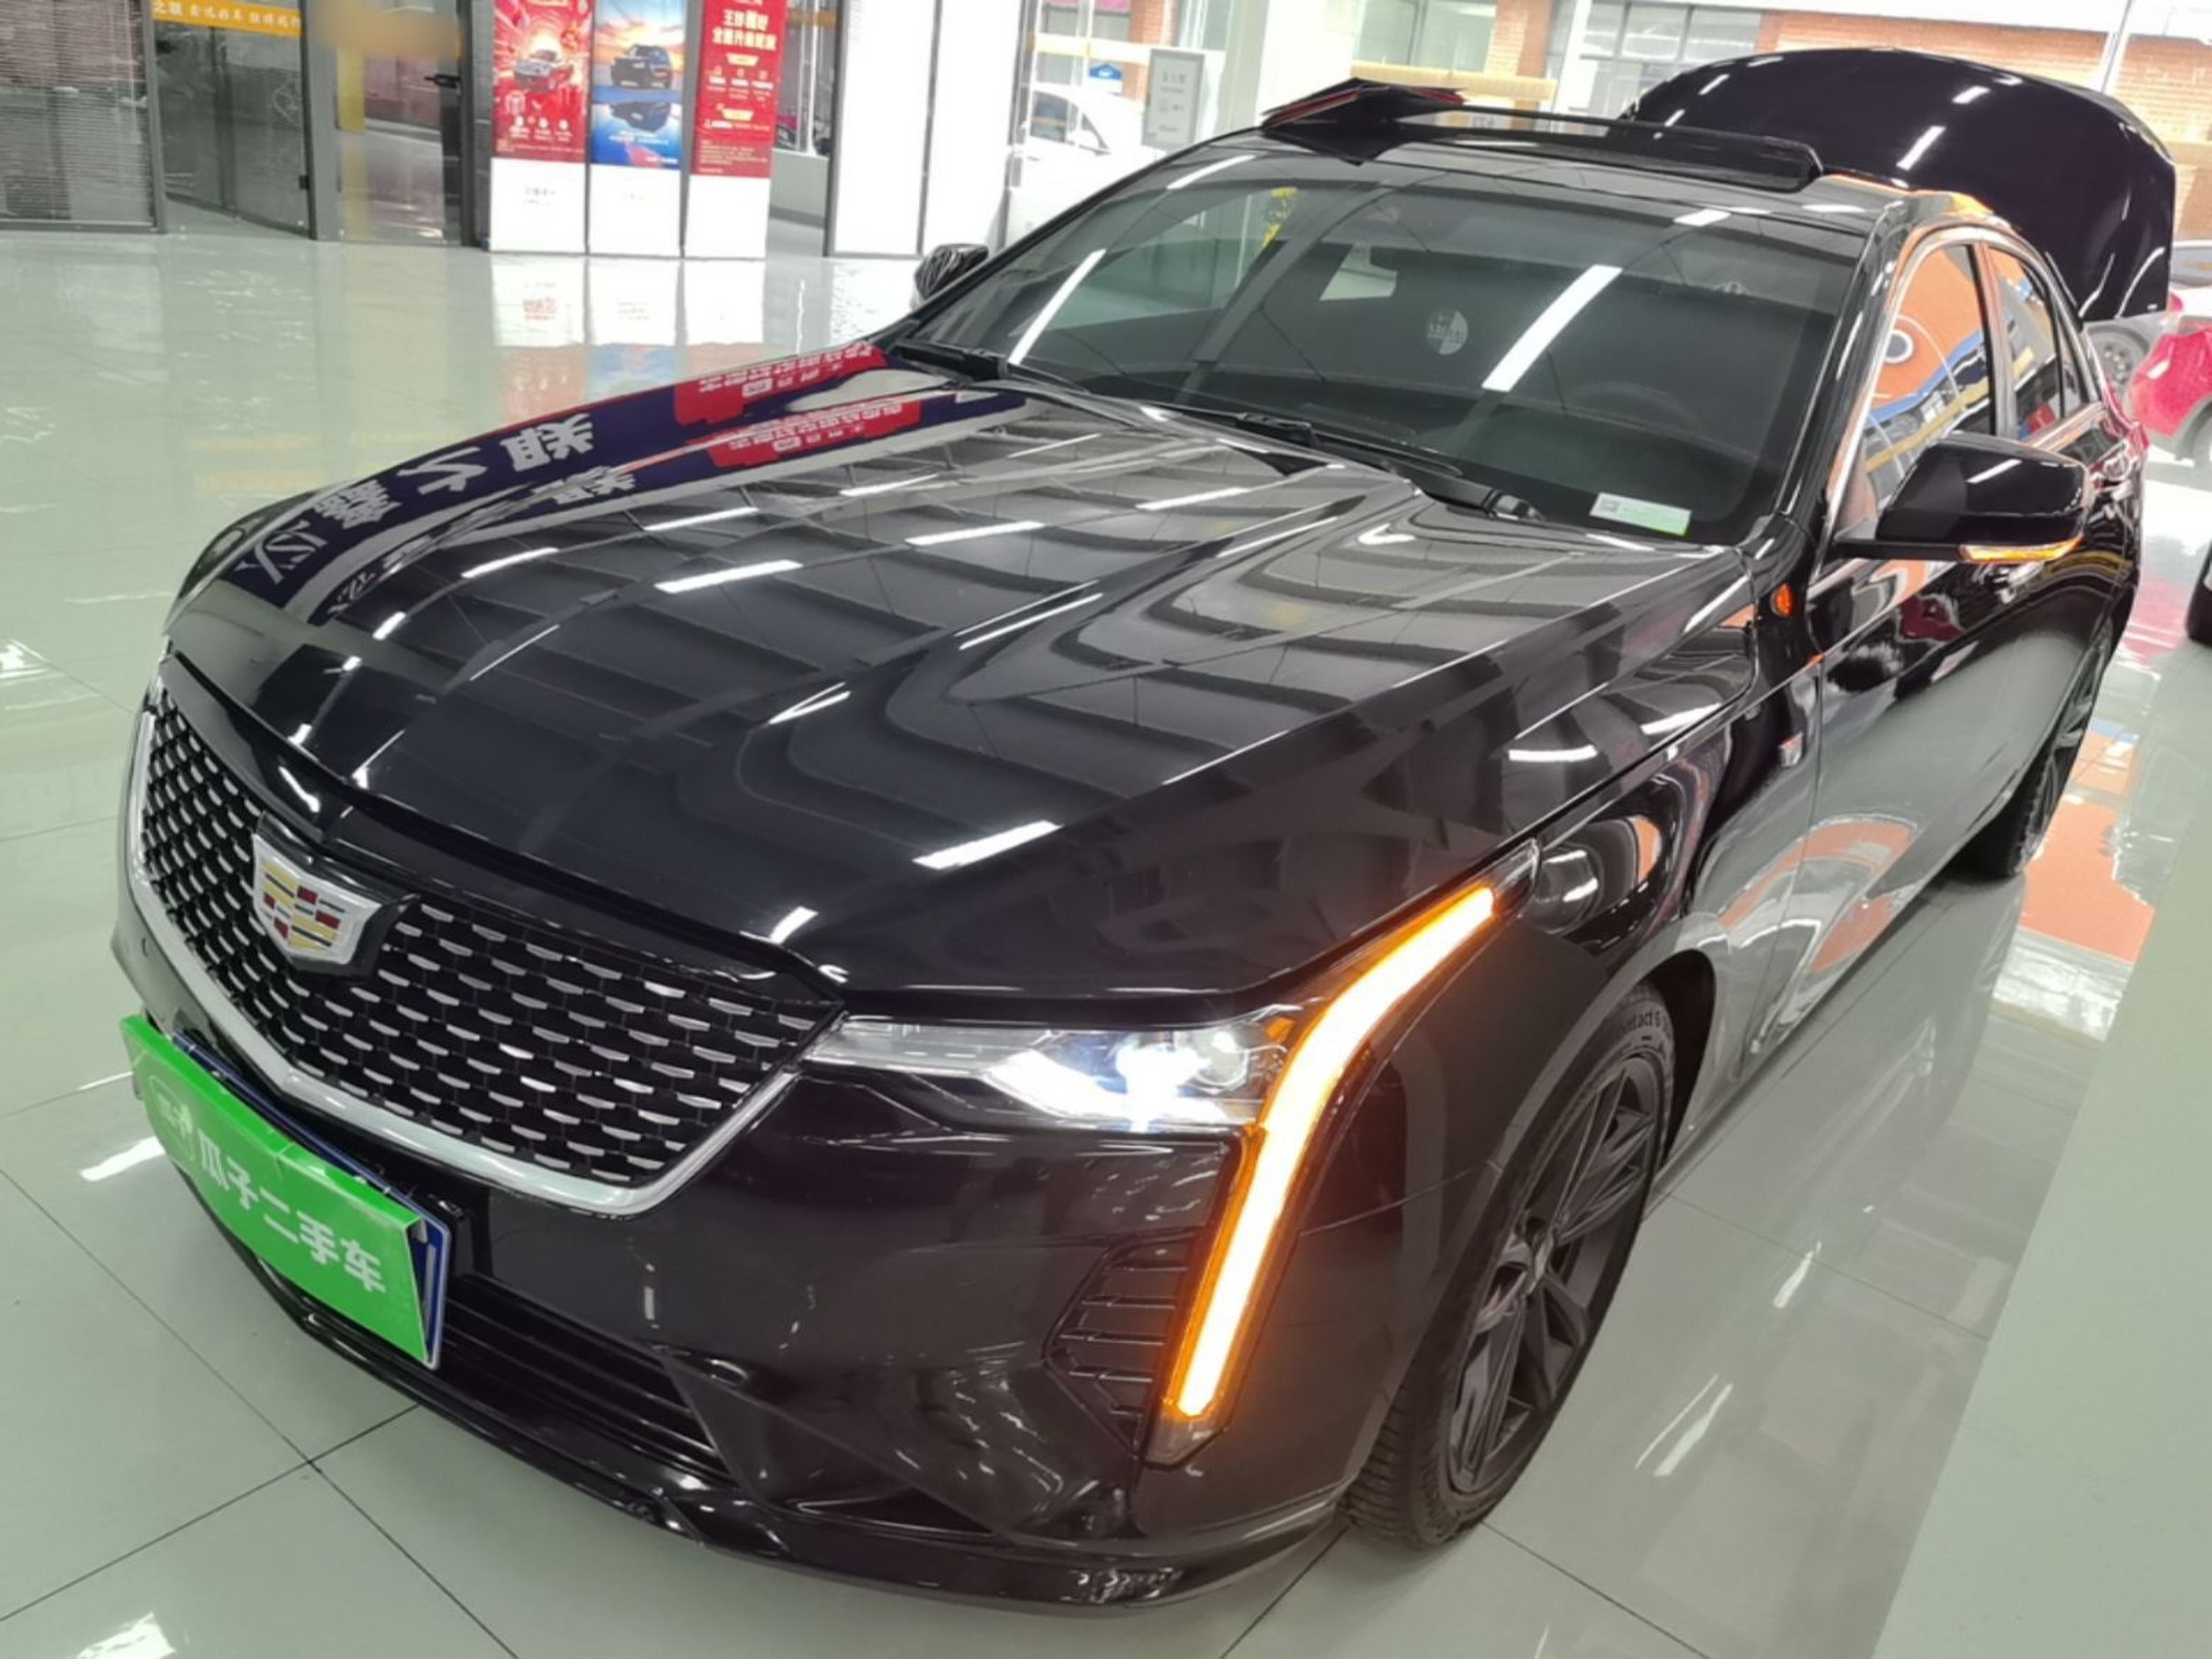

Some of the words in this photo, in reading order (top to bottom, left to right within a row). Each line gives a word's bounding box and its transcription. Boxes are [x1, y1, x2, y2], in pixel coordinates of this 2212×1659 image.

[197, 1127, 386, 1293] 瓜子二手车
